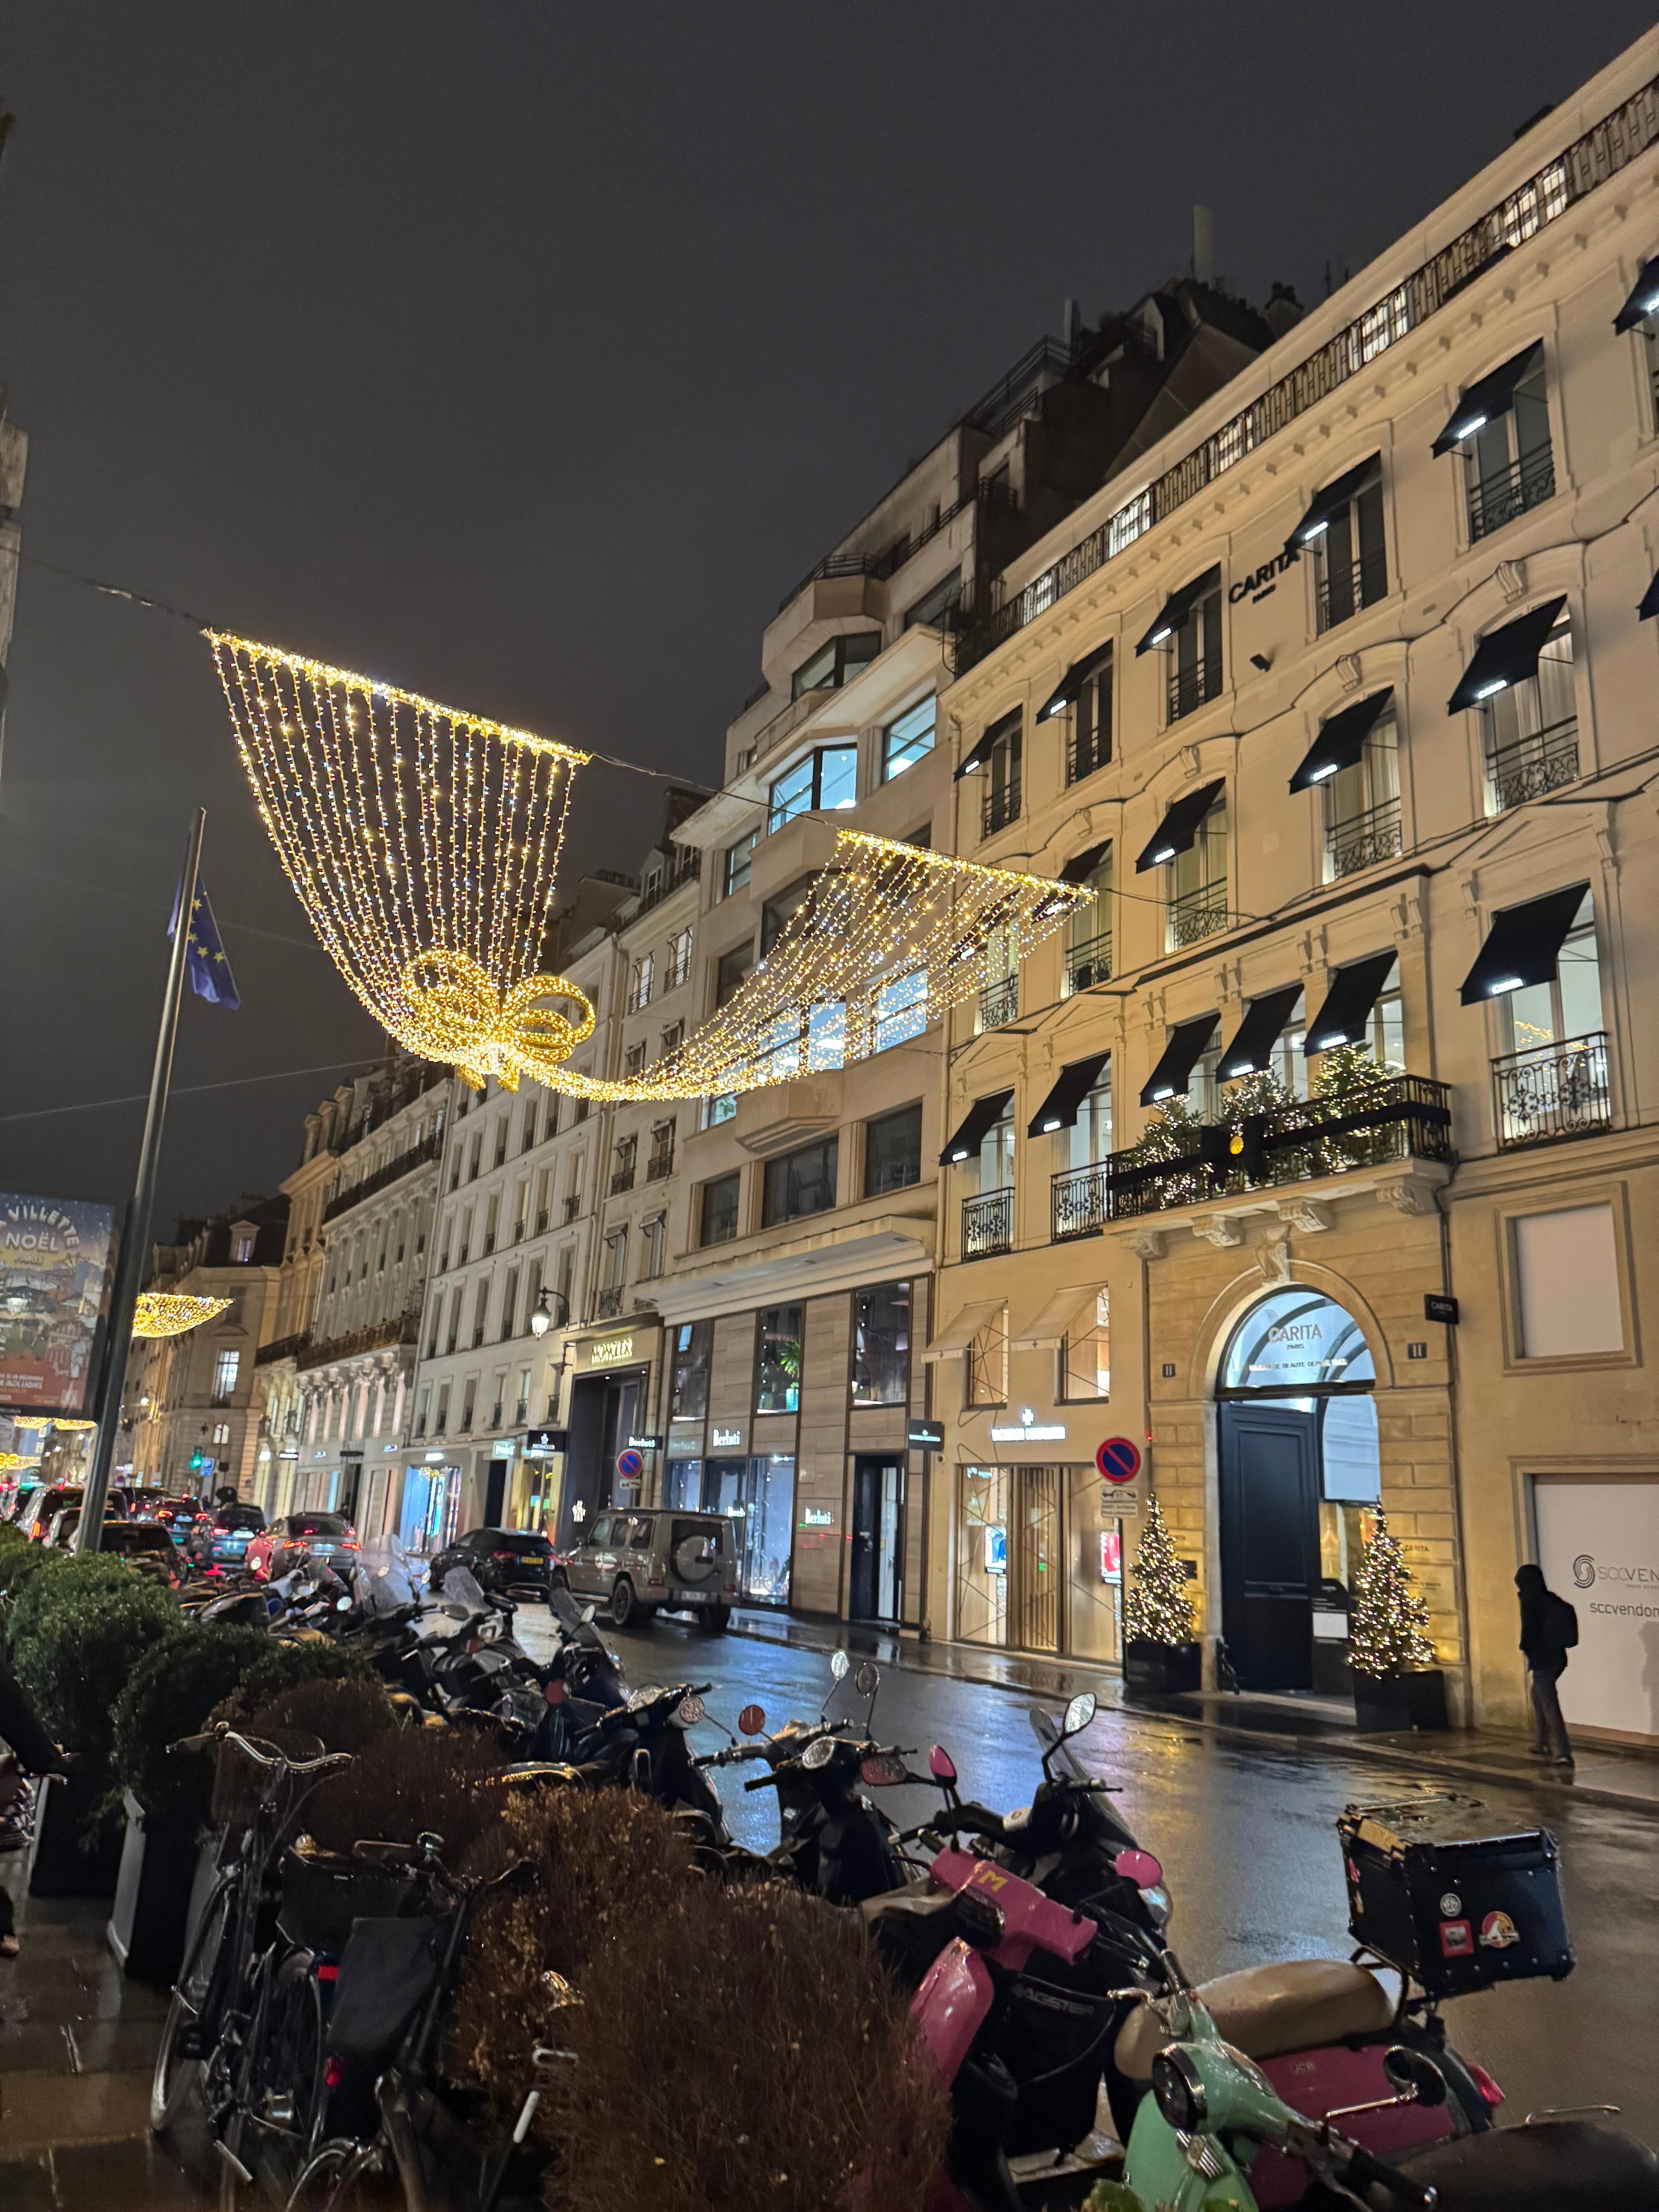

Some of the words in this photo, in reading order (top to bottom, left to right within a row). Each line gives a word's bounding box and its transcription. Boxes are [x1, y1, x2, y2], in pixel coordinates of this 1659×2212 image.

[1229, 552, 1300, 603] CARITA
[5, 1231, 59, 1251] NOËL
[1431, 1301, 1453, 1312] CARITA
[1268, 1324, 1322, 1343] CARITA
[591, 1338, 633, 1364] MONCLER
[1413, 1344, 1422, 1357] 11
[629, 1436, 655, 1448] Berluti
[713, 1429, 740, 1446] Berluti
[805, 1508, 831, 1525] Berluti
[978, 1870, 1007, 1891] M
